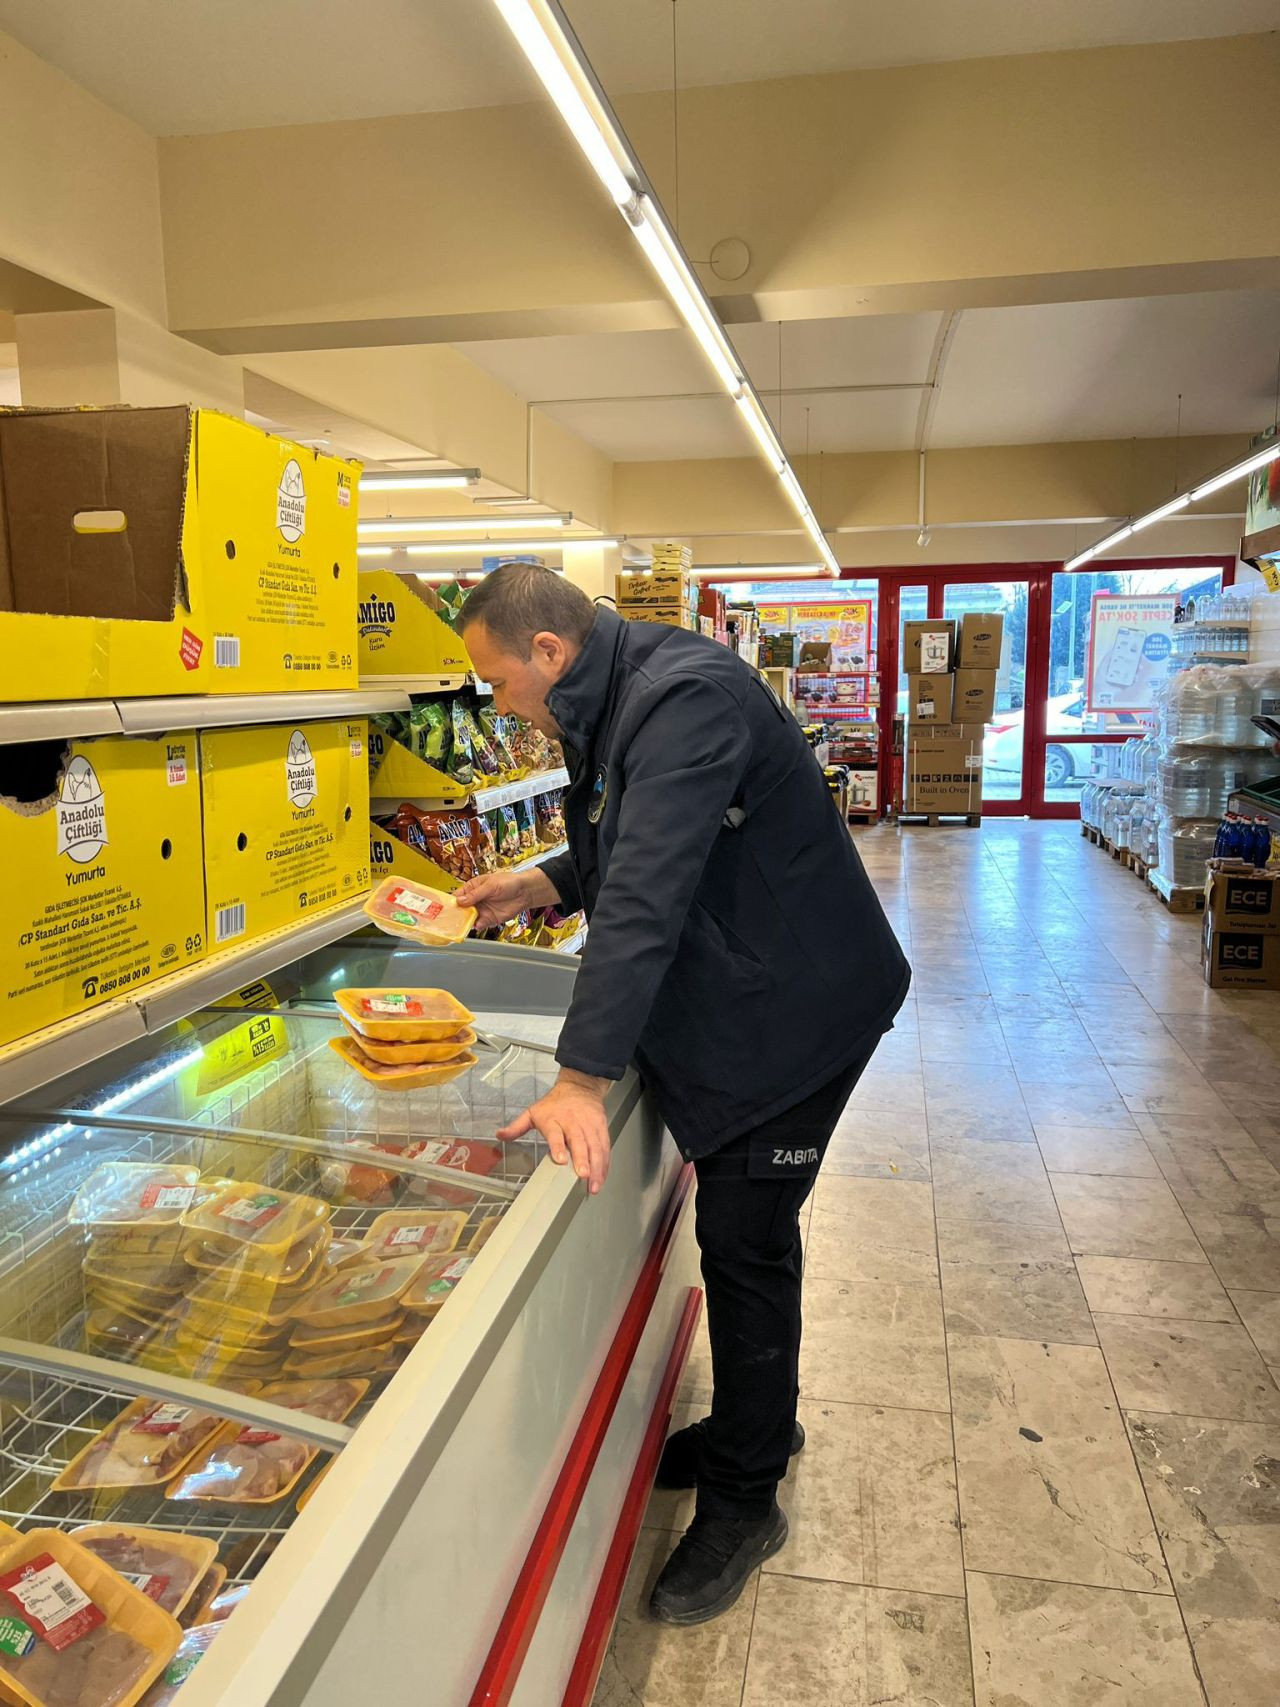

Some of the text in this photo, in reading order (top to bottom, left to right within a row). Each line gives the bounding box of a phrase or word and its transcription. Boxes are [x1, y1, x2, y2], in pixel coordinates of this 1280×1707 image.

[278, 497, 305, 513] Anadolu
[280, 511, 302, 527] Çiftliği
[278, 544, 301, 557] Yumurta
[288, 766, 315, 779] Anadolu
[290, 778, 313, 794] Çiftliği
[60, 804, 104, 825] Anadolu
[291, 808, 315, 820] Yumurta
[65, 820, 102, 843] Çiftliği
[65, 866, 105, 886] Yumurta
[1231, 889, 1267, 905] ECE
[35, 922, 70, 941] Standart
[71, 916, 89, 930] Gıda
[91, 911, 105, 924] San.
[107, 908, 115, 918] ve
[116, 903, 129, 915] Tic.
[1223, 944, 1259, 960] ECE
[100, 979, 117, 994] 0850
[132, 969, 140, 981] 00
[142, 965, 150, 976] 00
[772, 1147, 818, 1165] ZABITA
